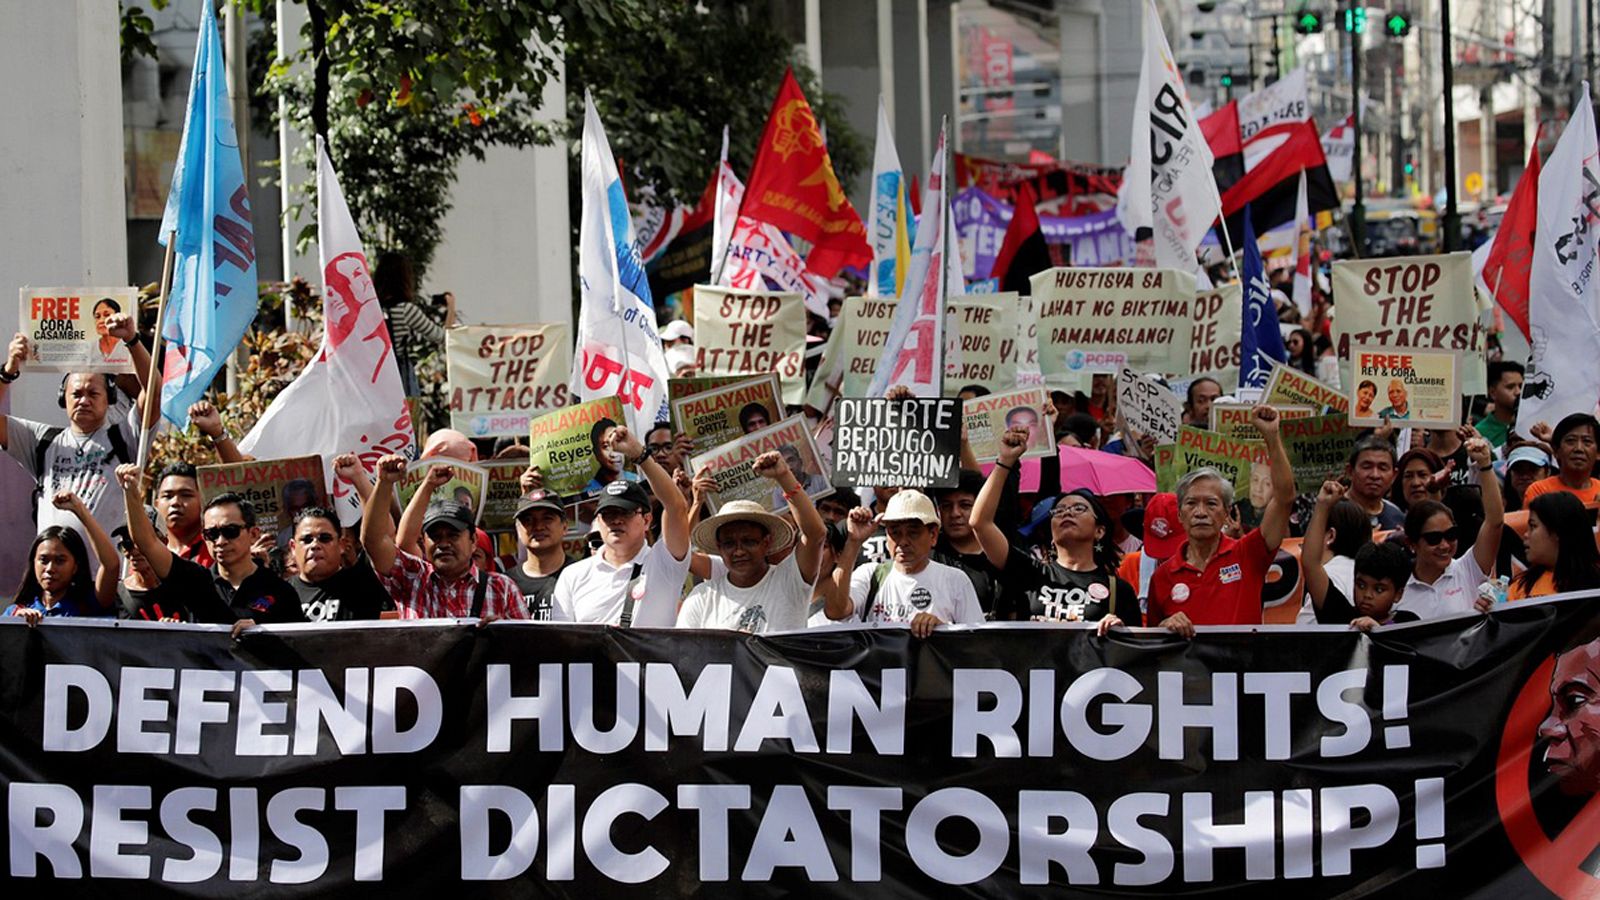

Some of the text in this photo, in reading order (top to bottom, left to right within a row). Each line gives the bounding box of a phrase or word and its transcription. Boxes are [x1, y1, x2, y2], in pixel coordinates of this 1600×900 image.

[1055, 271, 1163, 288] HUSTISYA SA
[1363, 263, 1441, 297] STOP
[31, 297, 80, 320] FREE
[720, 293, 782, 320] STOP
[857, 302, 993, 324] JUST THE
[1040, 299, 1189, 319] LAHAT NG BIKTIMA
[1378, 294, 1435, 327] THE
[33, 330, 86, 341] CASAMBRE
[40, 319, 74, 331] CORA
[728, 323, 774, 347] THE
[478, 334, 545, 359] STOP
[959, 335, 991, 352] RUG
[490, 358, 540, 384] THE
[1361, 353, 1413, 369] FREE
[1361, 367, 1416, 378] REY & CORA
[1122, 368, 1159, 399] STOP
[684, 382, 769, 419] PALAYAIN!
[963, 386, 1037, 416] LAYAIN!
[1122, 386, 1177, 429] ATTACKS
[490, 417, 529, 430] PCPR
[532, 399, 620, 440] PALAYAIN!
[692, 411, 727, 427] DENNIS
[839, 398, 955, 430] DUTERTE
[696, 419, 730, 436] ORTIZ
[546, 431, 591, 450] Alexander
[837, 426, 936, 454] BERDUGO
[1293, 438, 1354, 454] Marklen
[549, 444, 593, 465] Reyes
[835, 450, 955, 480] PATALSIKIN!
[1184, 451, 1239, 475] Vicente
[1302, 451, 1345, 466] Maga
[42, 661, 1411, 762] DEFEND HUMAN RIGHTS!
[8, 776, 1447, 885] RESIST DICTATORSHIP!
